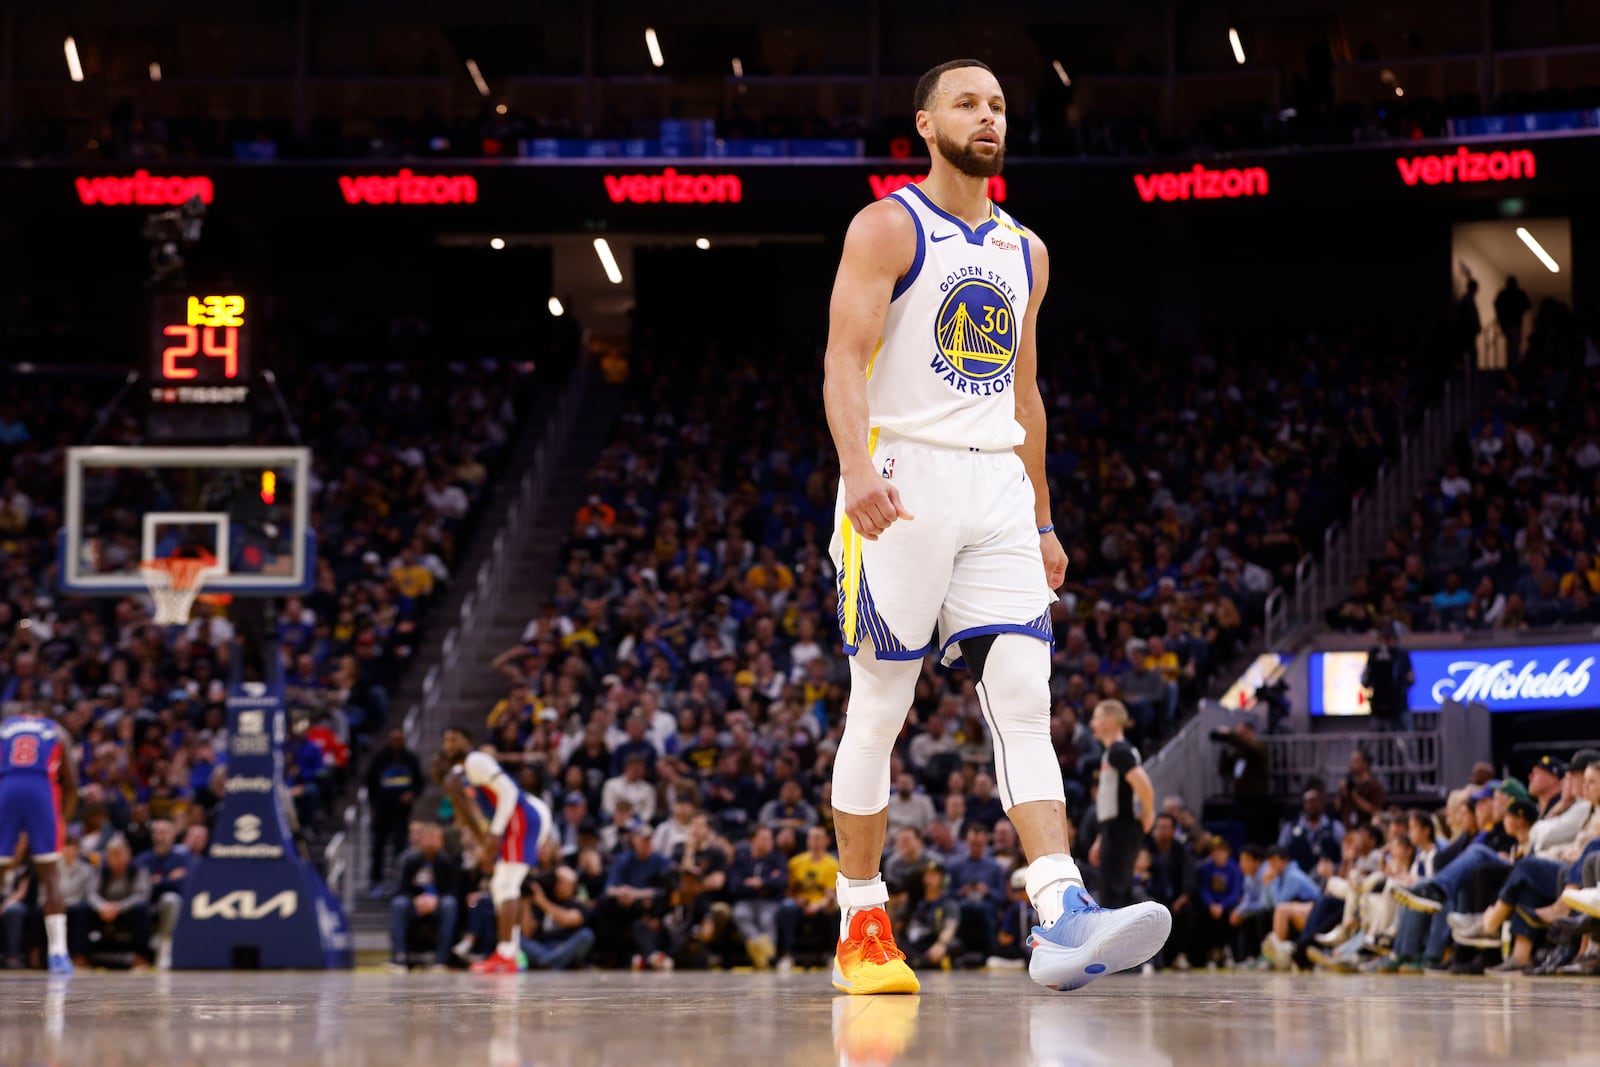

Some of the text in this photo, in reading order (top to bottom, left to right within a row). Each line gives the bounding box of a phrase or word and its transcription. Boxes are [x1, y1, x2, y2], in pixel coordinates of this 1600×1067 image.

[1133, 164, 1269, 202] verizon
[1396, 146, 1536, 186] verizon
[75, 169, 214, 205] verizon
[338, 168, 478, 204] verizon
[603, 167, 742, 203] verizon
[991, 237, 1020, 252] Rakuten
[939, 266, 1017, 304] GOLDEN STATE
[187, 295, 245, 327] 1:32
[980, 305, 1009, 335] 30
[162, 325, 239, 379] 24
[1431, 656, 1597, 705] Michelob
[9, 733, 40, 769] 8
